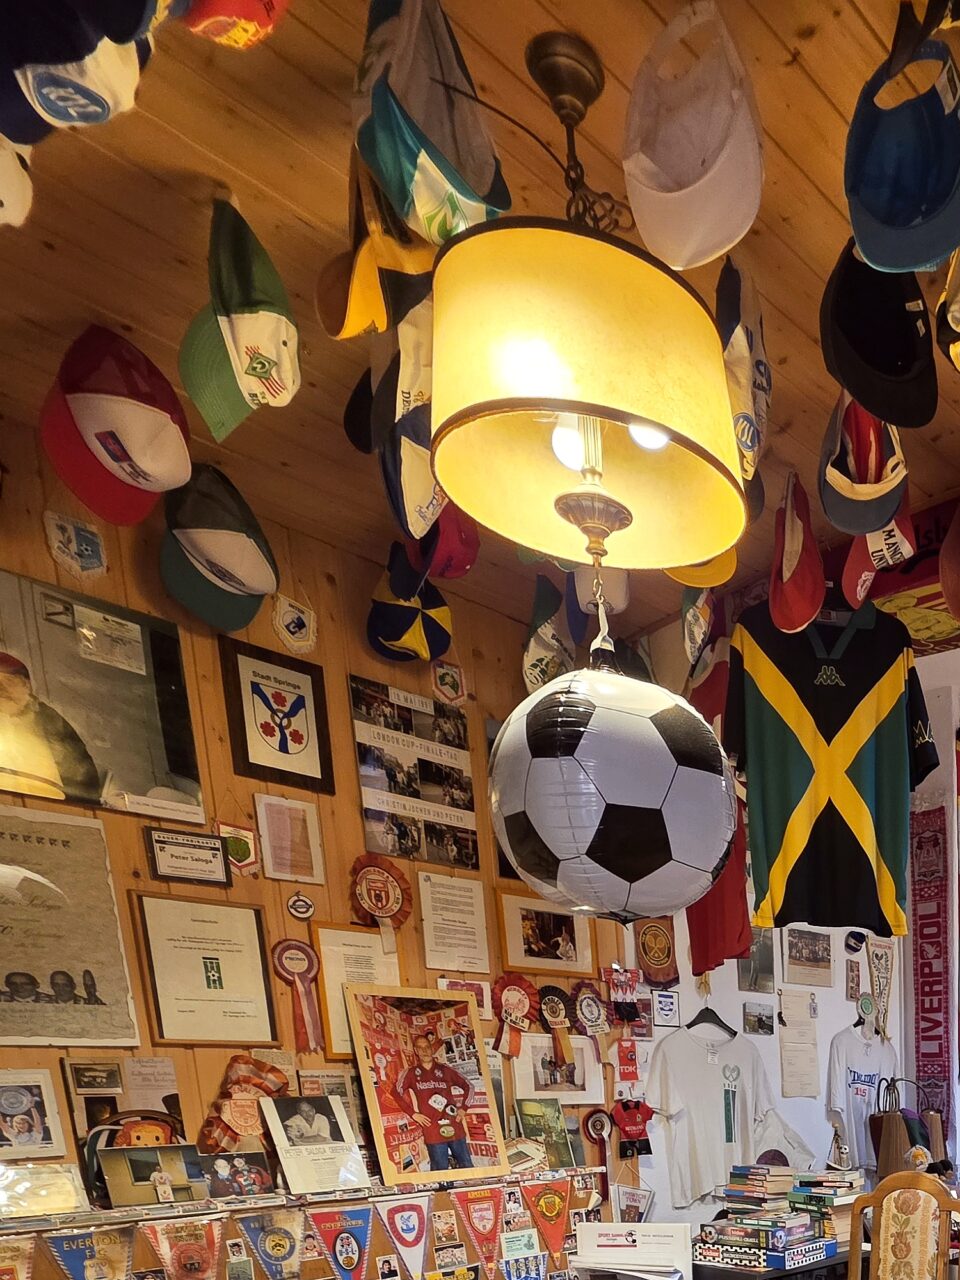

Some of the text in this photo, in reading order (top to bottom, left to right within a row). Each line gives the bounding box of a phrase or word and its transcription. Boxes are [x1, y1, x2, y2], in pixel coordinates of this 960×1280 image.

[252, 670, 301, 690] Stadt Springe
[919, 901, 943, 1060] LIVERPOOL
[619, 1065, 638, 1073] TDK
[416, 1081, 447, 1091] Nashua
[467, 1189, 492, 1198] ARSENAL
[63, 1234, 122, 1251] EVERTON
